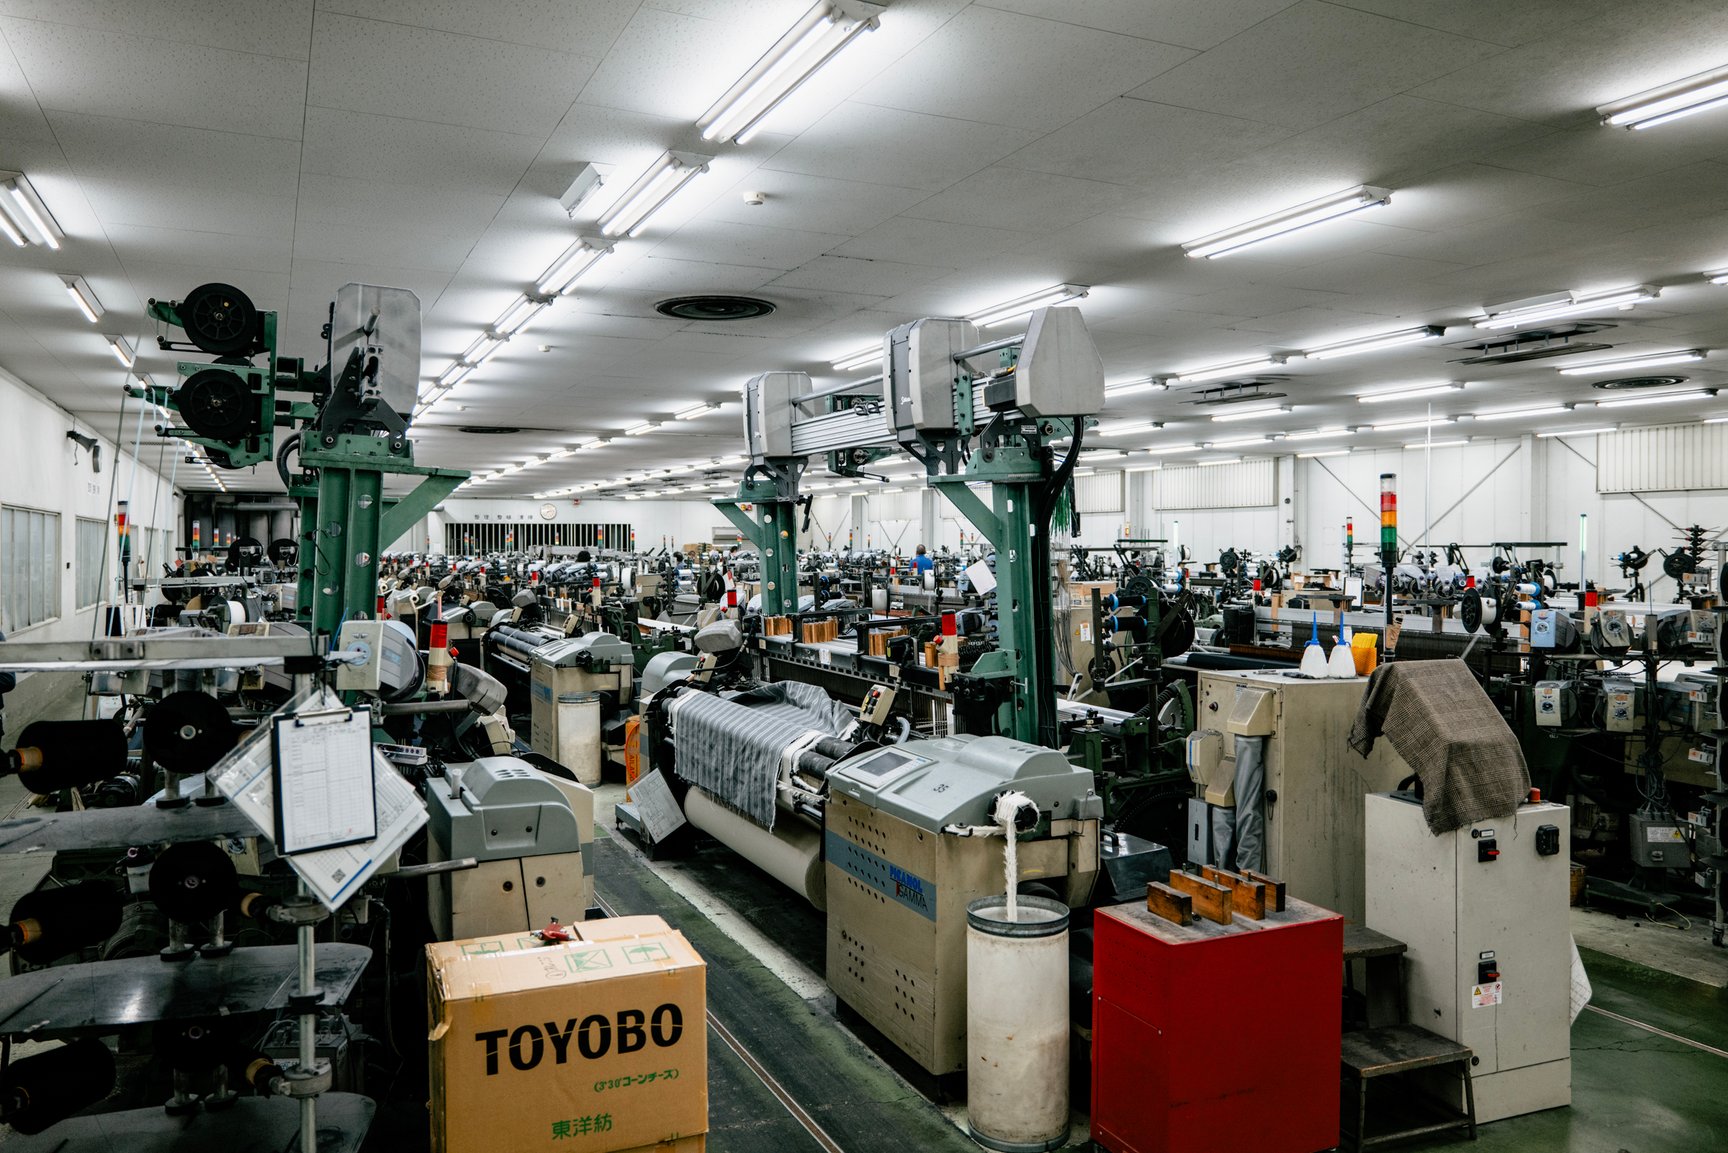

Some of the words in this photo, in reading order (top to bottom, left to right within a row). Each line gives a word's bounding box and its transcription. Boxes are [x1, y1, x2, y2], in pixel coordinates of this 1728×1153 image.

[475, 1003, 683, 1076] TOYOBO
[551, 1112, 612, 1140] 東洋紡
